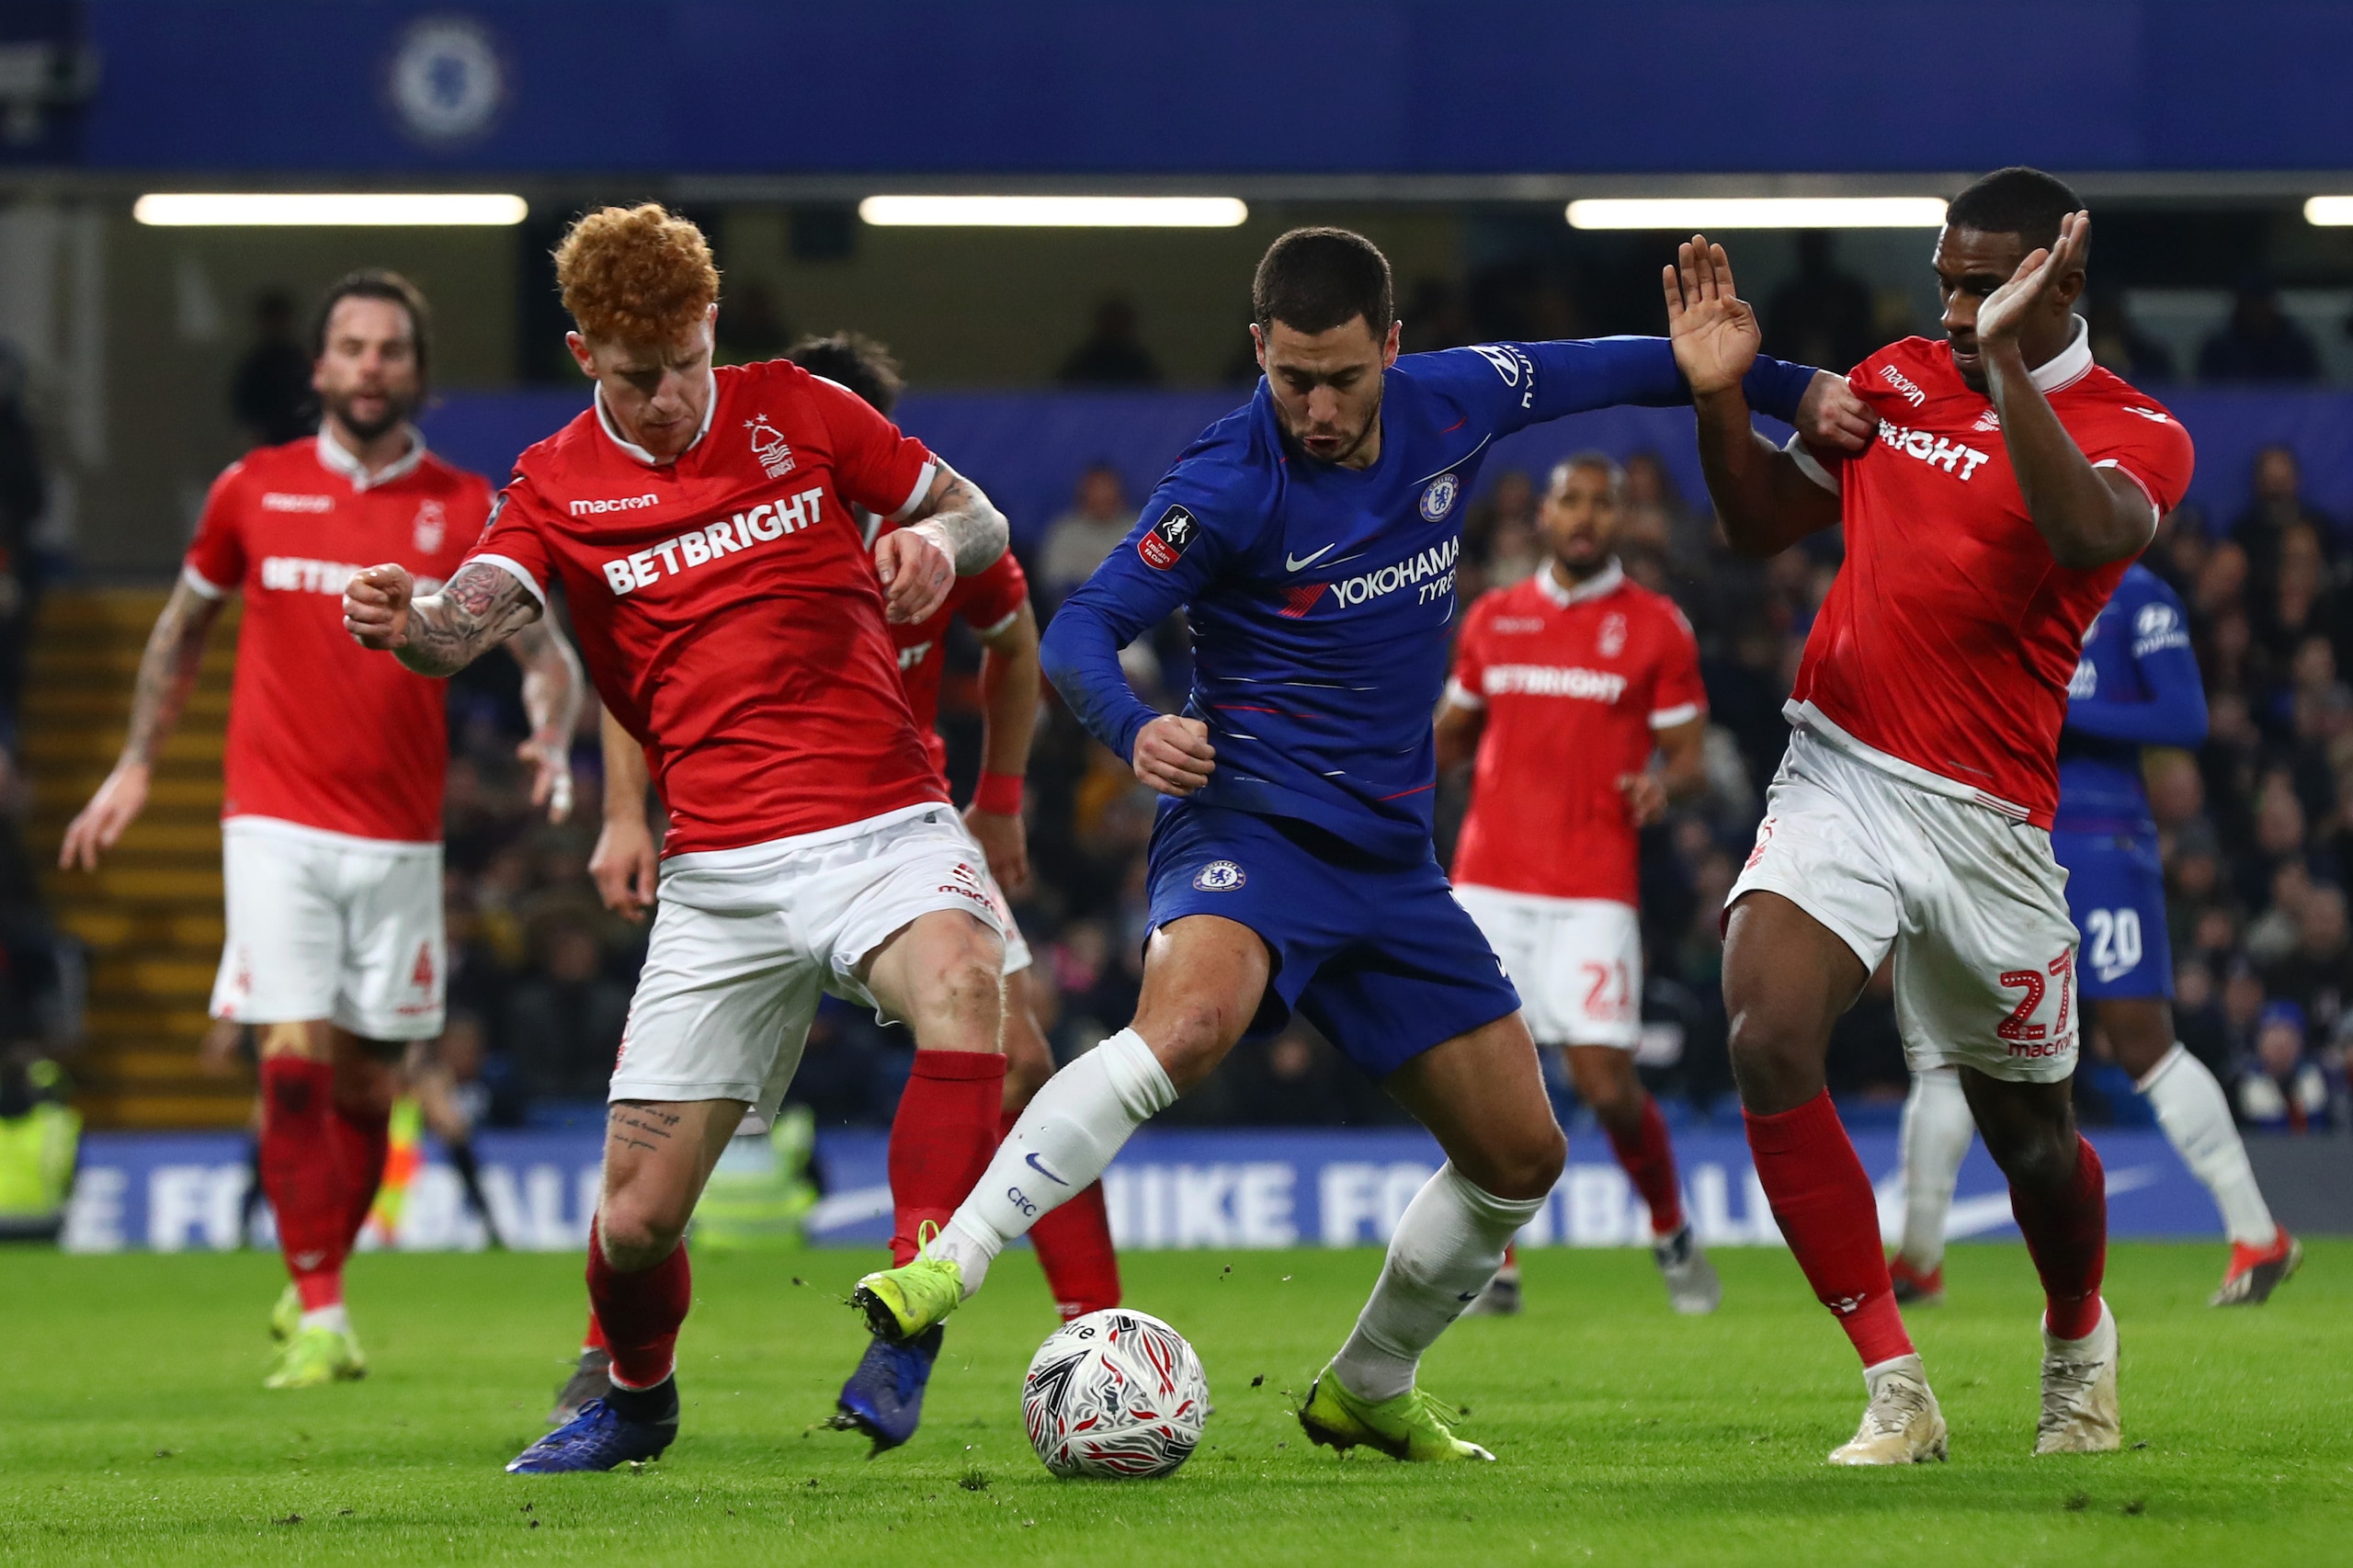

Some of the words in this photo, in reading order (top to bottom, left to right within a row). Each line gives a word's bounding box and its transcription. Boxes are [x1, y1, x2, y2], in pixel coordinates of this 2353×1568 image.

[1878, 364, 1927, 408] macron
[569, 494, 660, 517] macron
[602, 486, 824, 597] BETBRIGHT
[1329, 534, 1461, 609] YOKOHAMA
[1481, 664, 1630, 705] BETBRIGHT
[2086, 907, 2144, 968] 20
[1579, 958, 1631, 1013] 21
[1996, 947, 2073, 1041] 27
[2007, 1030, 2074, 1058] macron
[1007, 1187, 1037, 1218] CFC
